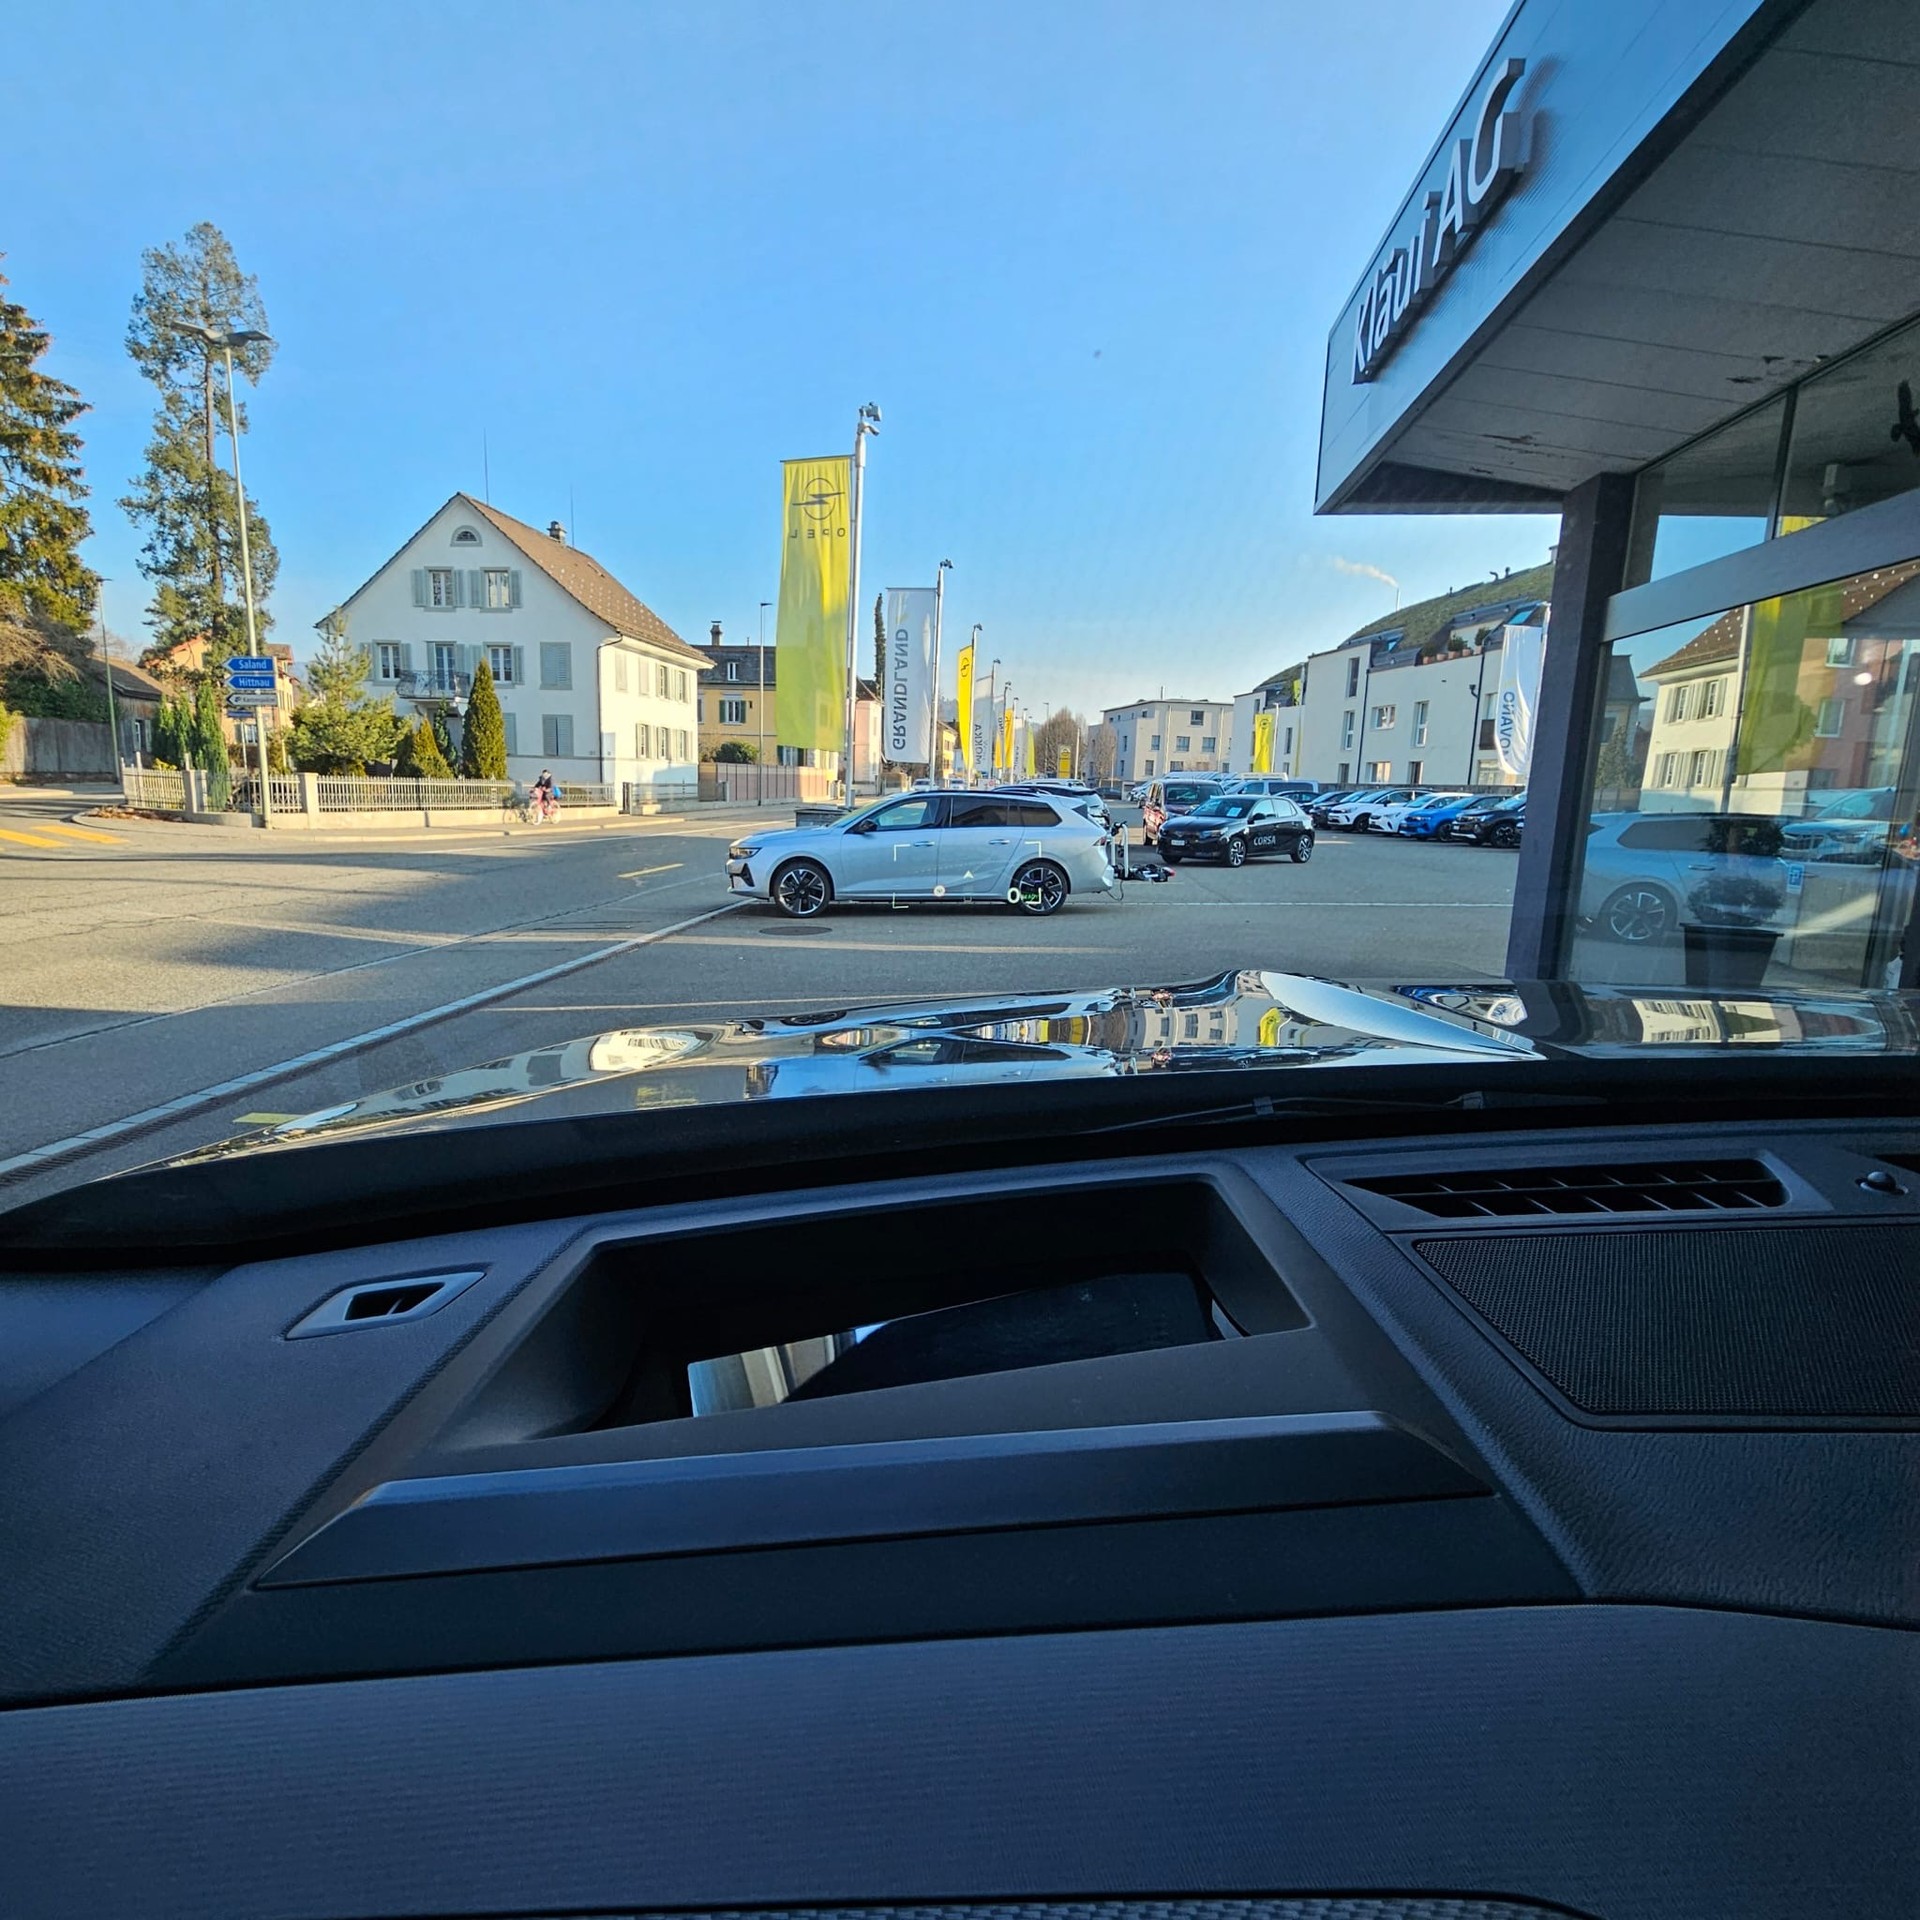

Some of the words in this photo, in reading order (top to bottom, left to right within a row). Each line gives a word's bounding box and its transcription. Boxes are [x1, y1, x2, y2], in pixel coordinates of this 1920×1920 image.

[1351, 190, 1438, 384] Kläui
[1433, 58, 1524, 269] AG
[238, 660, 267, 670] Saland
[238, 678, 270, 687] Hittnau
[1253, 835, 1276, 846] CORSA
